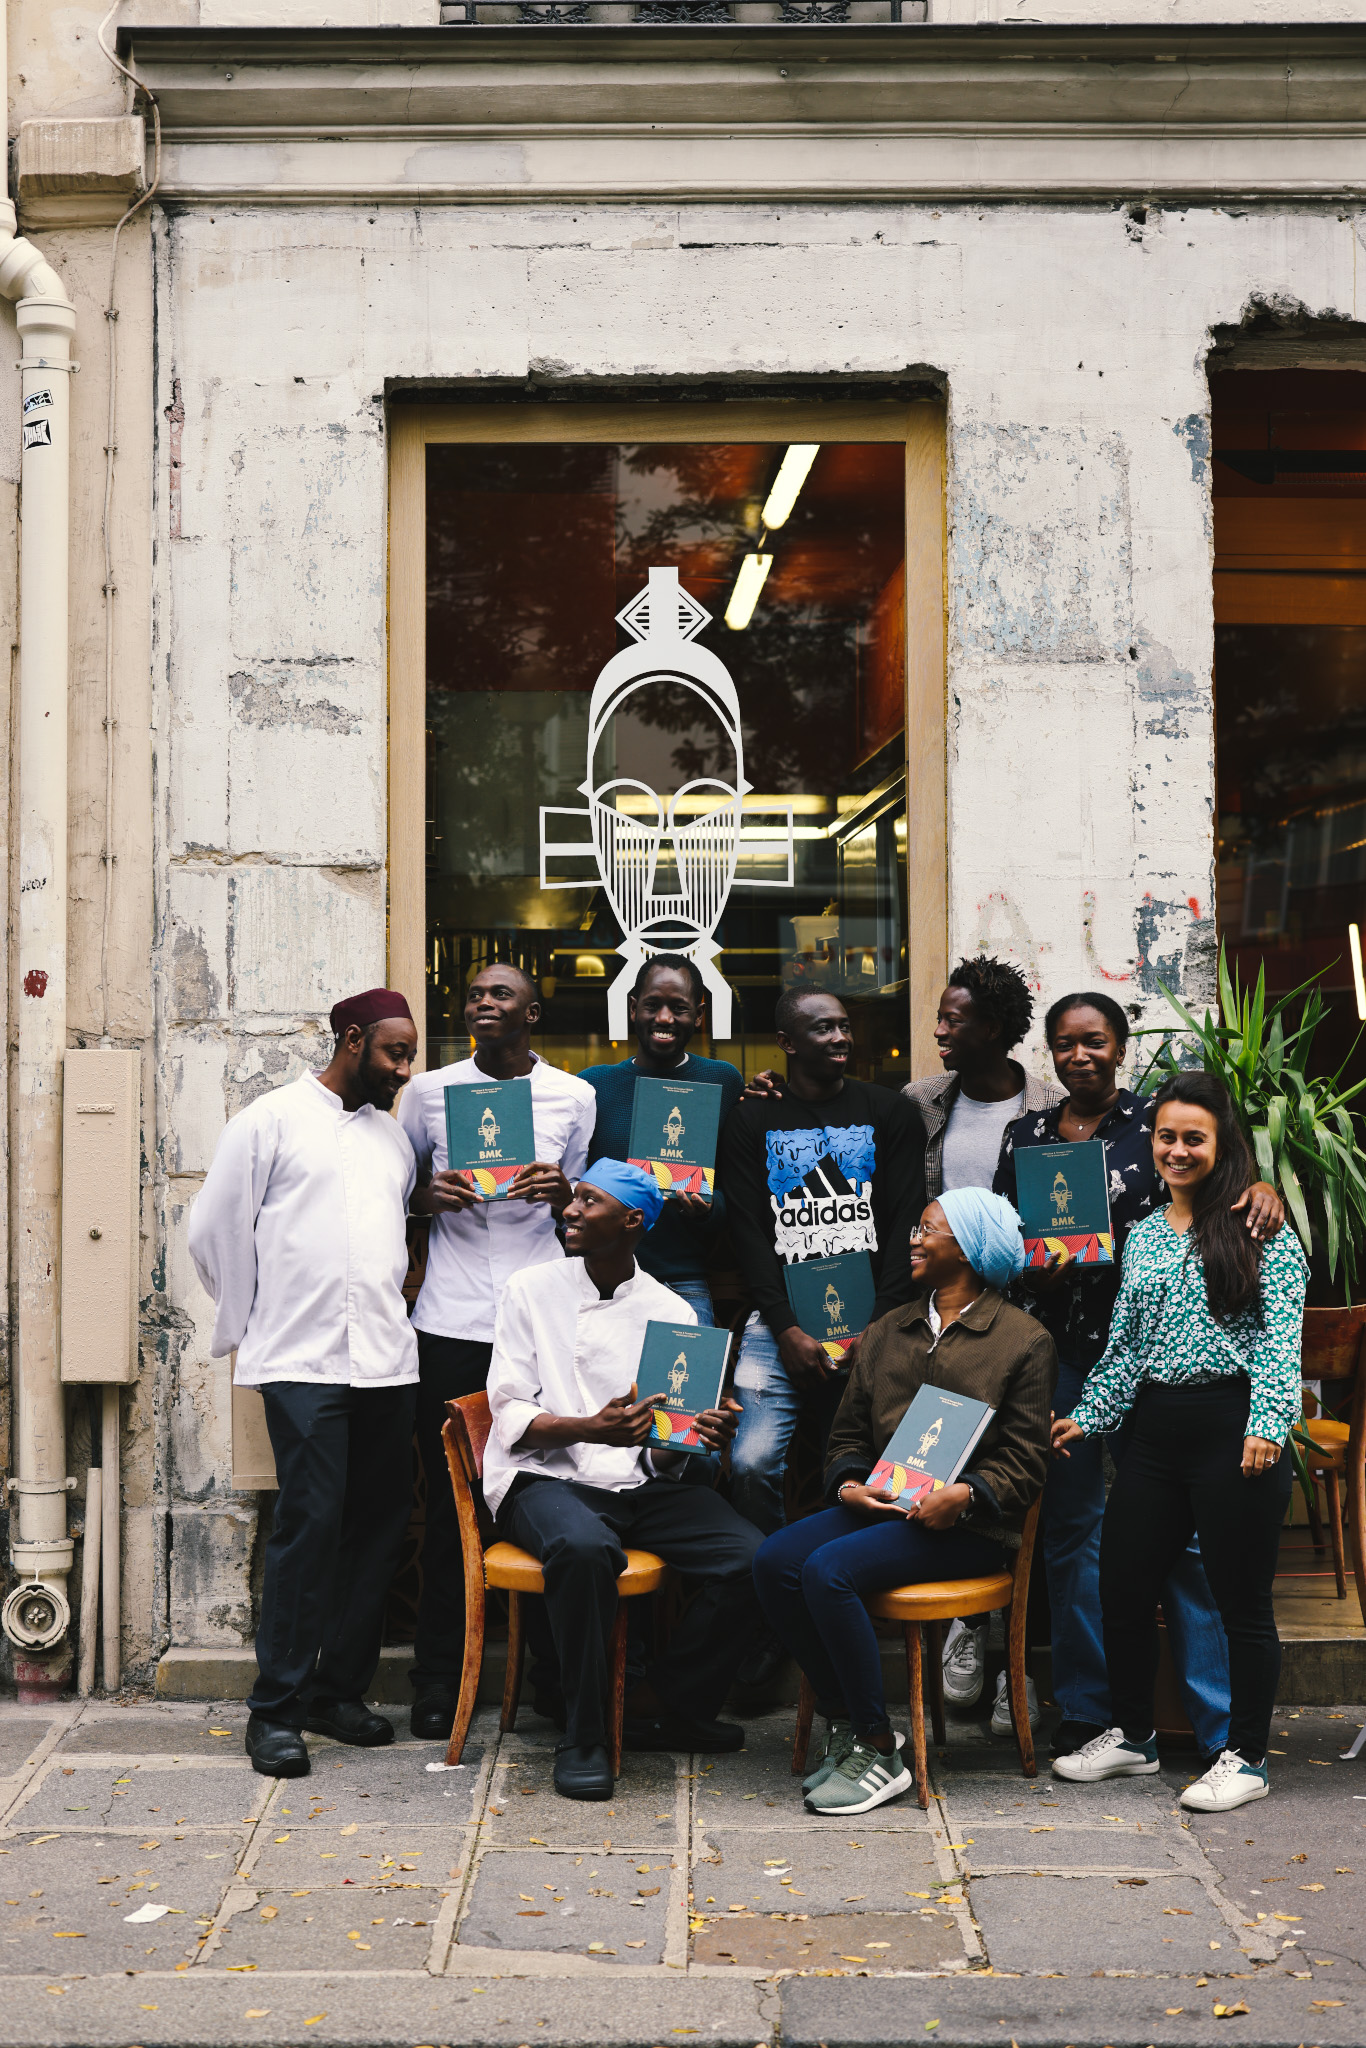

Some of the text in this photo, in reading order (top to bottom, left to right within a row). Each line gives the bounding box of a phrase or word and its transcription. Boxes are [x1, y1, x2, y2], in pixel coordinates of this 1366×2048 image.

[479, 1149, 503, 1159] BMK
[660, 1148, 684, 1158] BMK
[780, 1199, 871, 1228] adidas
[1051, 1216, 1076, 1227] BMK
[826, 1325, 850, 1336] BMK
[906, 1455, 928, 1469] BMK
